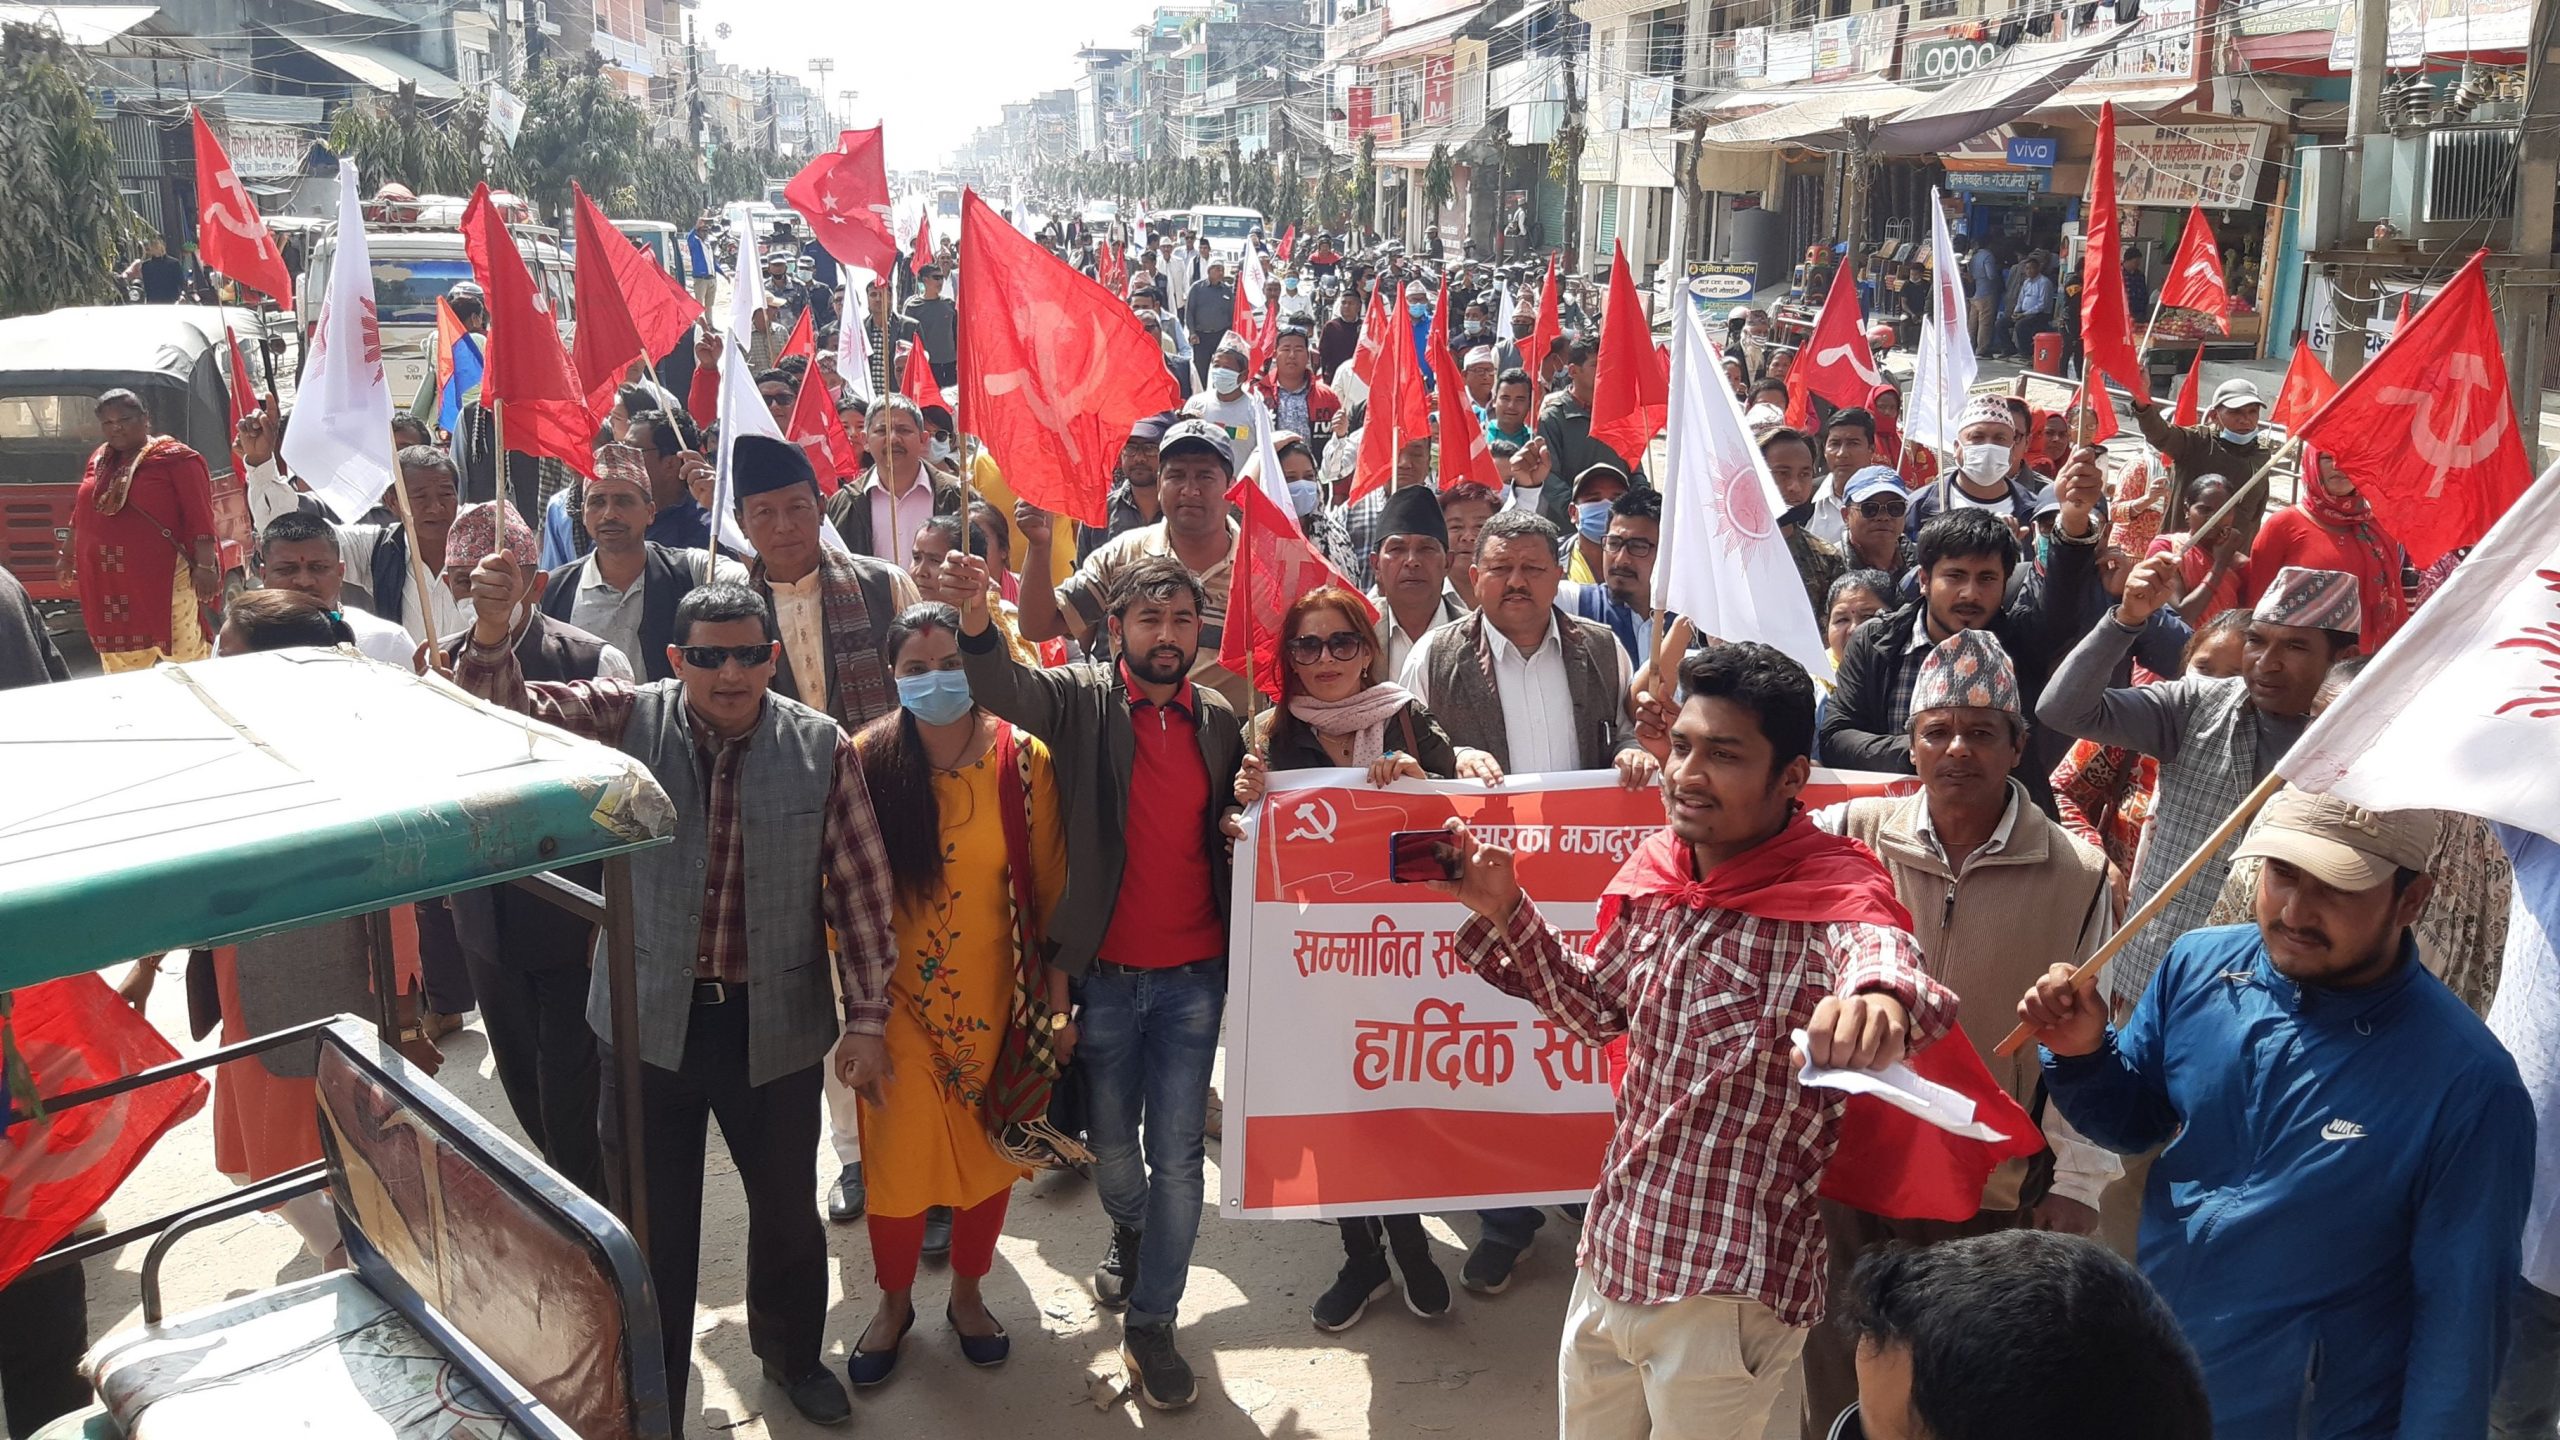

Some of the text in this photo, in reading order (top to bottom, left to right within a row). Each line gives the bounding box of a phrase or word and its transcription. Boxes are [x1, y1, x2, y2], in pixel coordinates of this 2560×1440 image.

[1430, 59, 1448, 118] ATM
[2015, 140, 2048, 159] vivo
[2155, 126, 2190, 141] BNK
[1293, 914, 1425, 978] सम्मानित
[1353, 998, 1518, 1091] हार्दिक
[2329, 1118, 2363, 1136] NIKE
